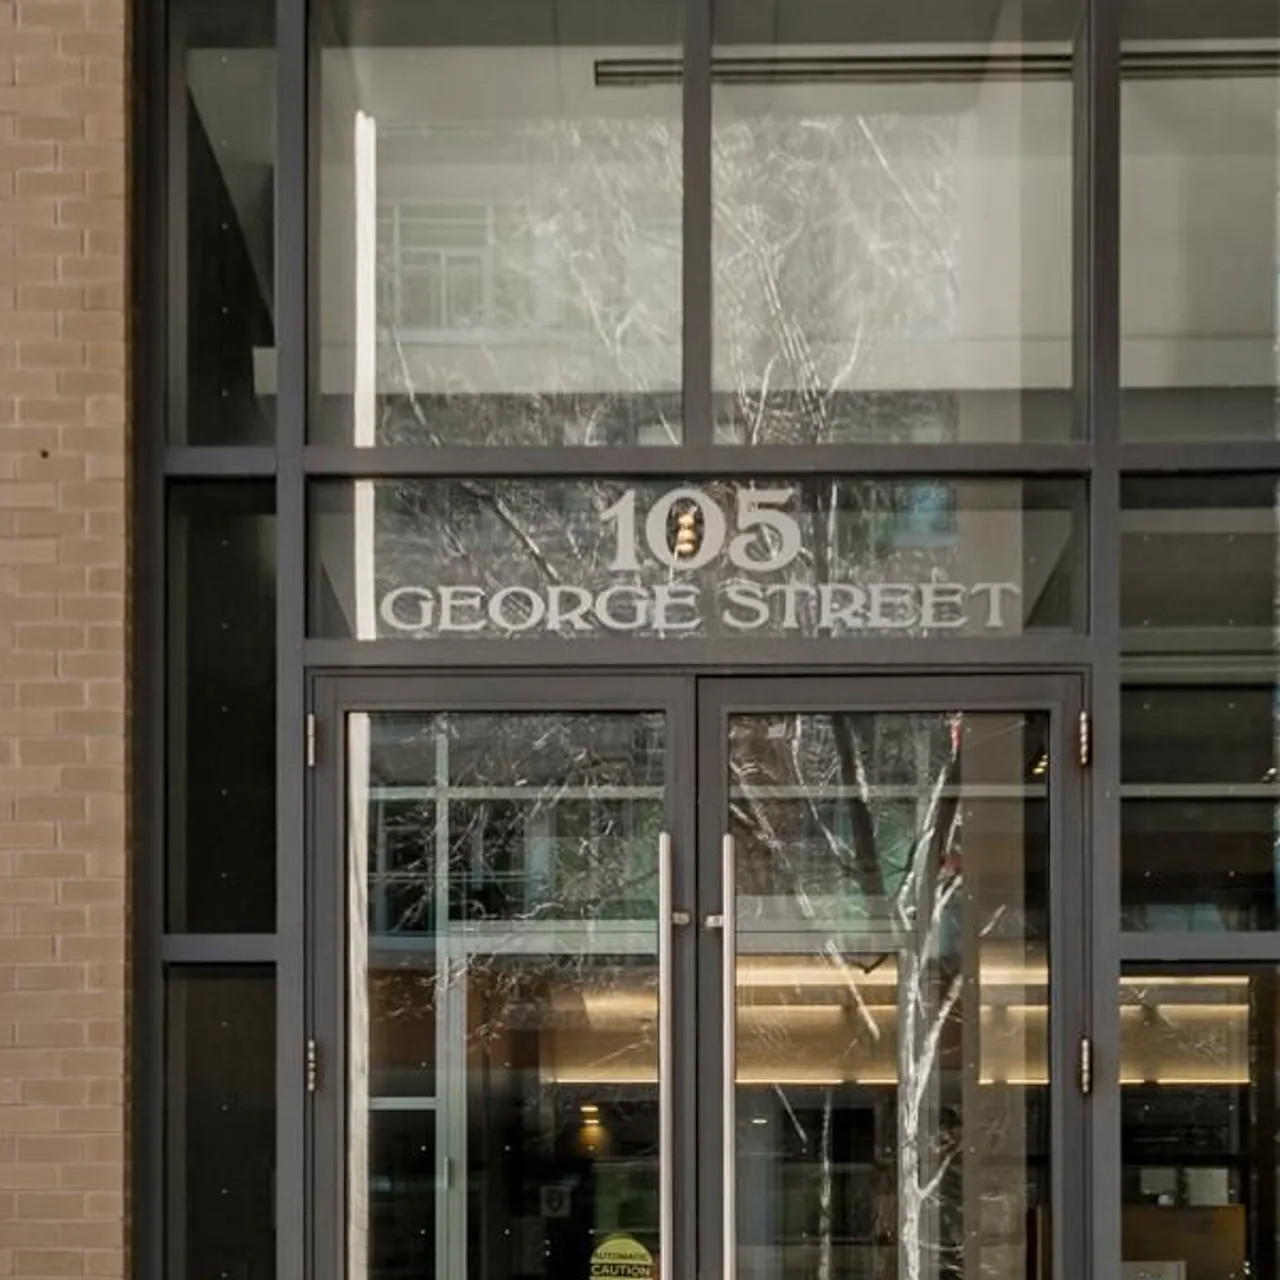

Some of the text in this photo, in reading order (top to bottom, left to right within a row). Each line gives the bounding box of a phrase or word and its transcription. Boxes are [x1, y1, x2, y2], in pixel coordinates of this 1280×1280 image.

[600, 488, 802, 571] 105
[379, 581, 1022, 632] GEORGE STREET
[590, 1264, 651, 1277] CAUTION
